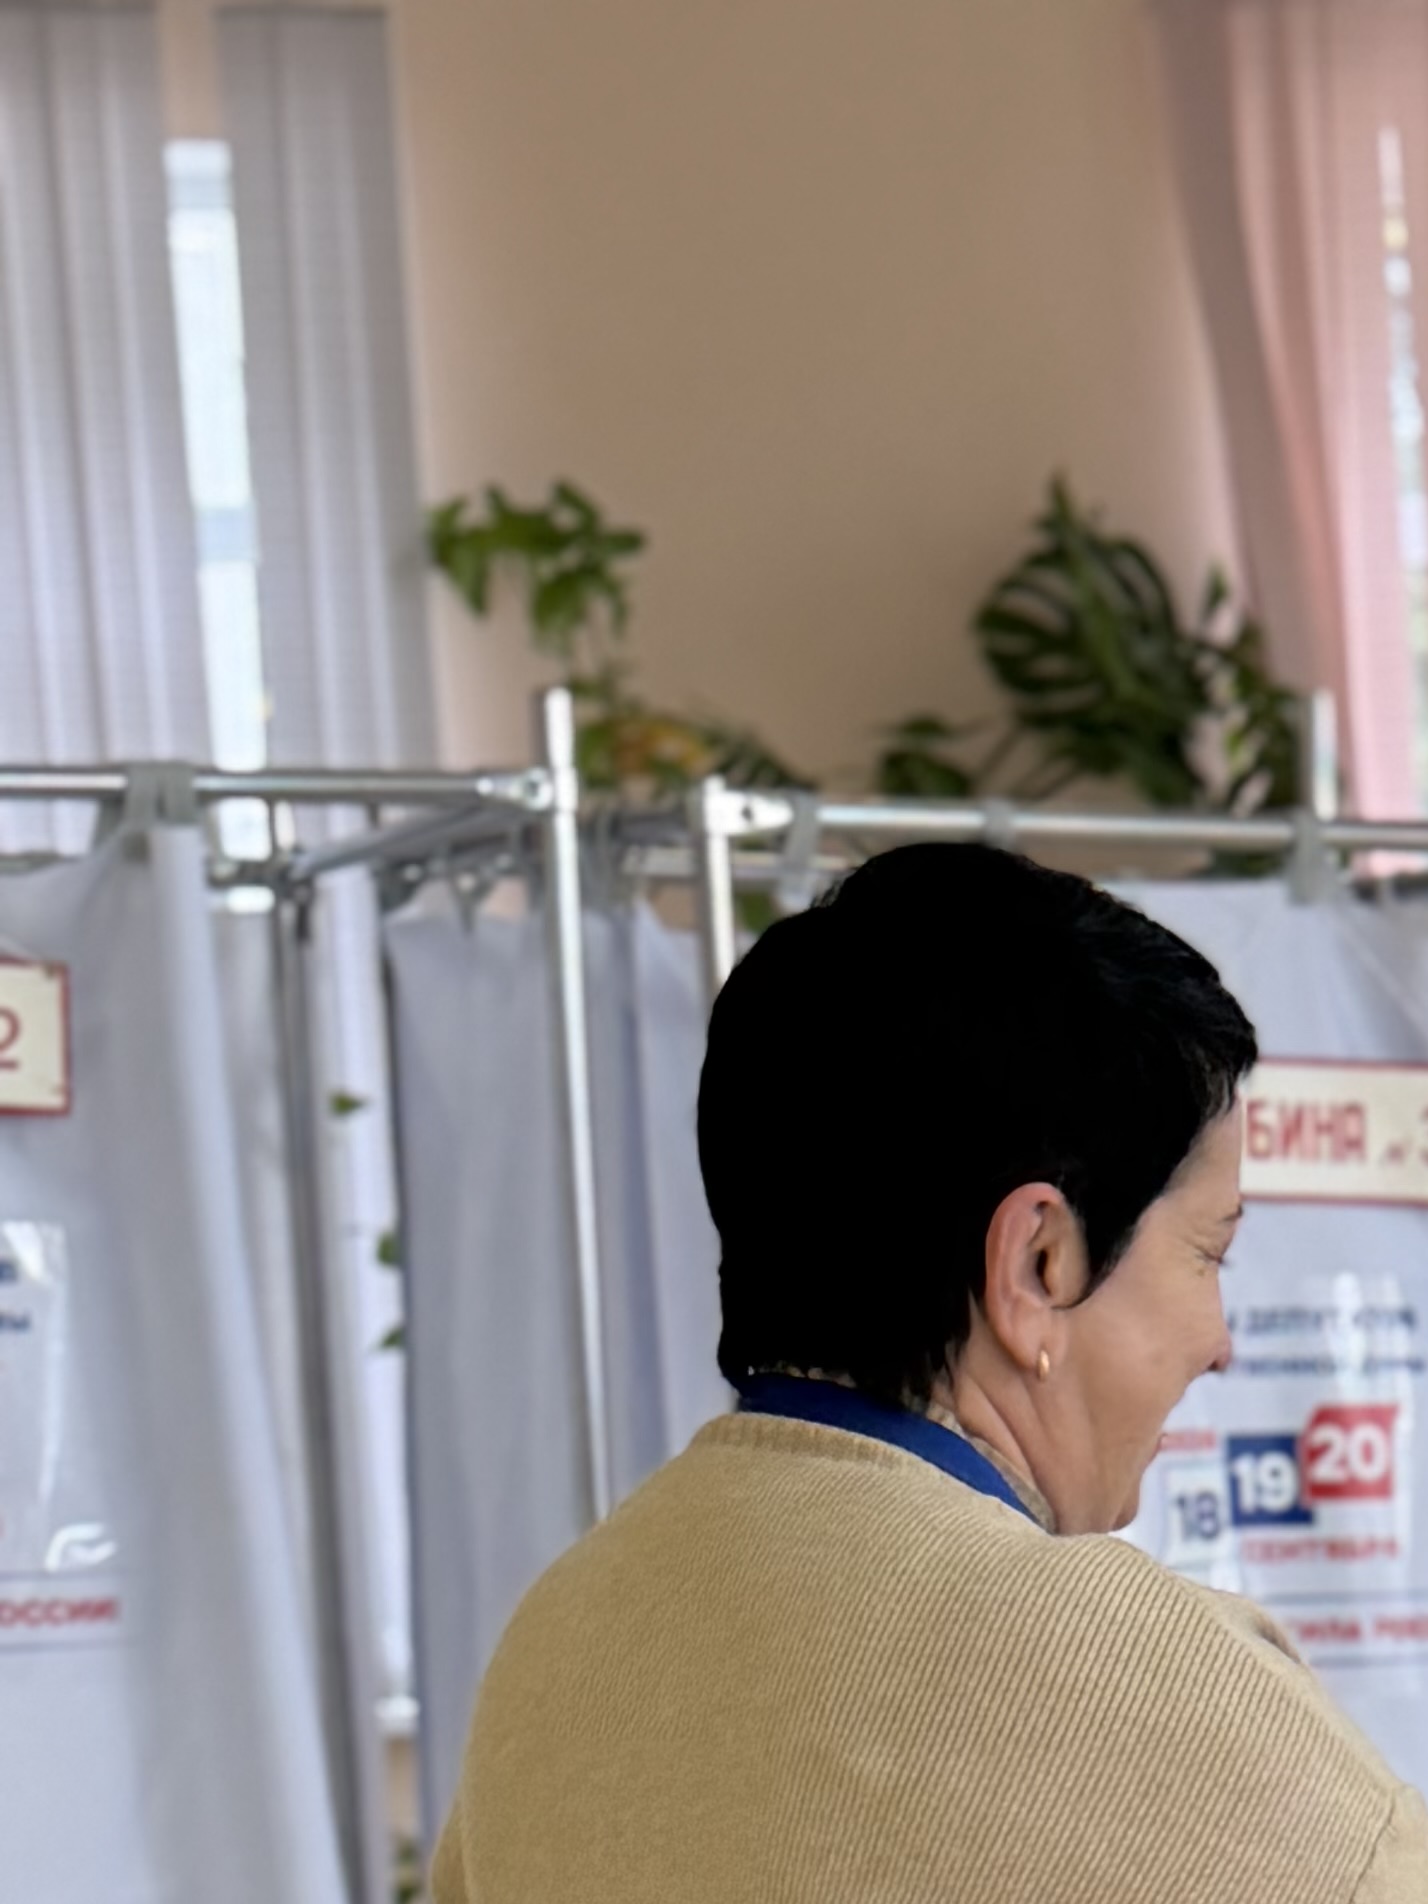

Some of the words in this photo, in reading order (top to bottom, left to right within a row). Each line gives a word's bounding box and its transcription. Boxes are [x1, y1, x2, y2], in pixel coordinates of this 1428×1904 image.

[1245, 1100, 1367, 1165] БИНА
[1174, 1490, 1222, 1541] 18
[1233, 1450, 1297, 1513] 19
[1310, 1423, 1389, 1484] 20
